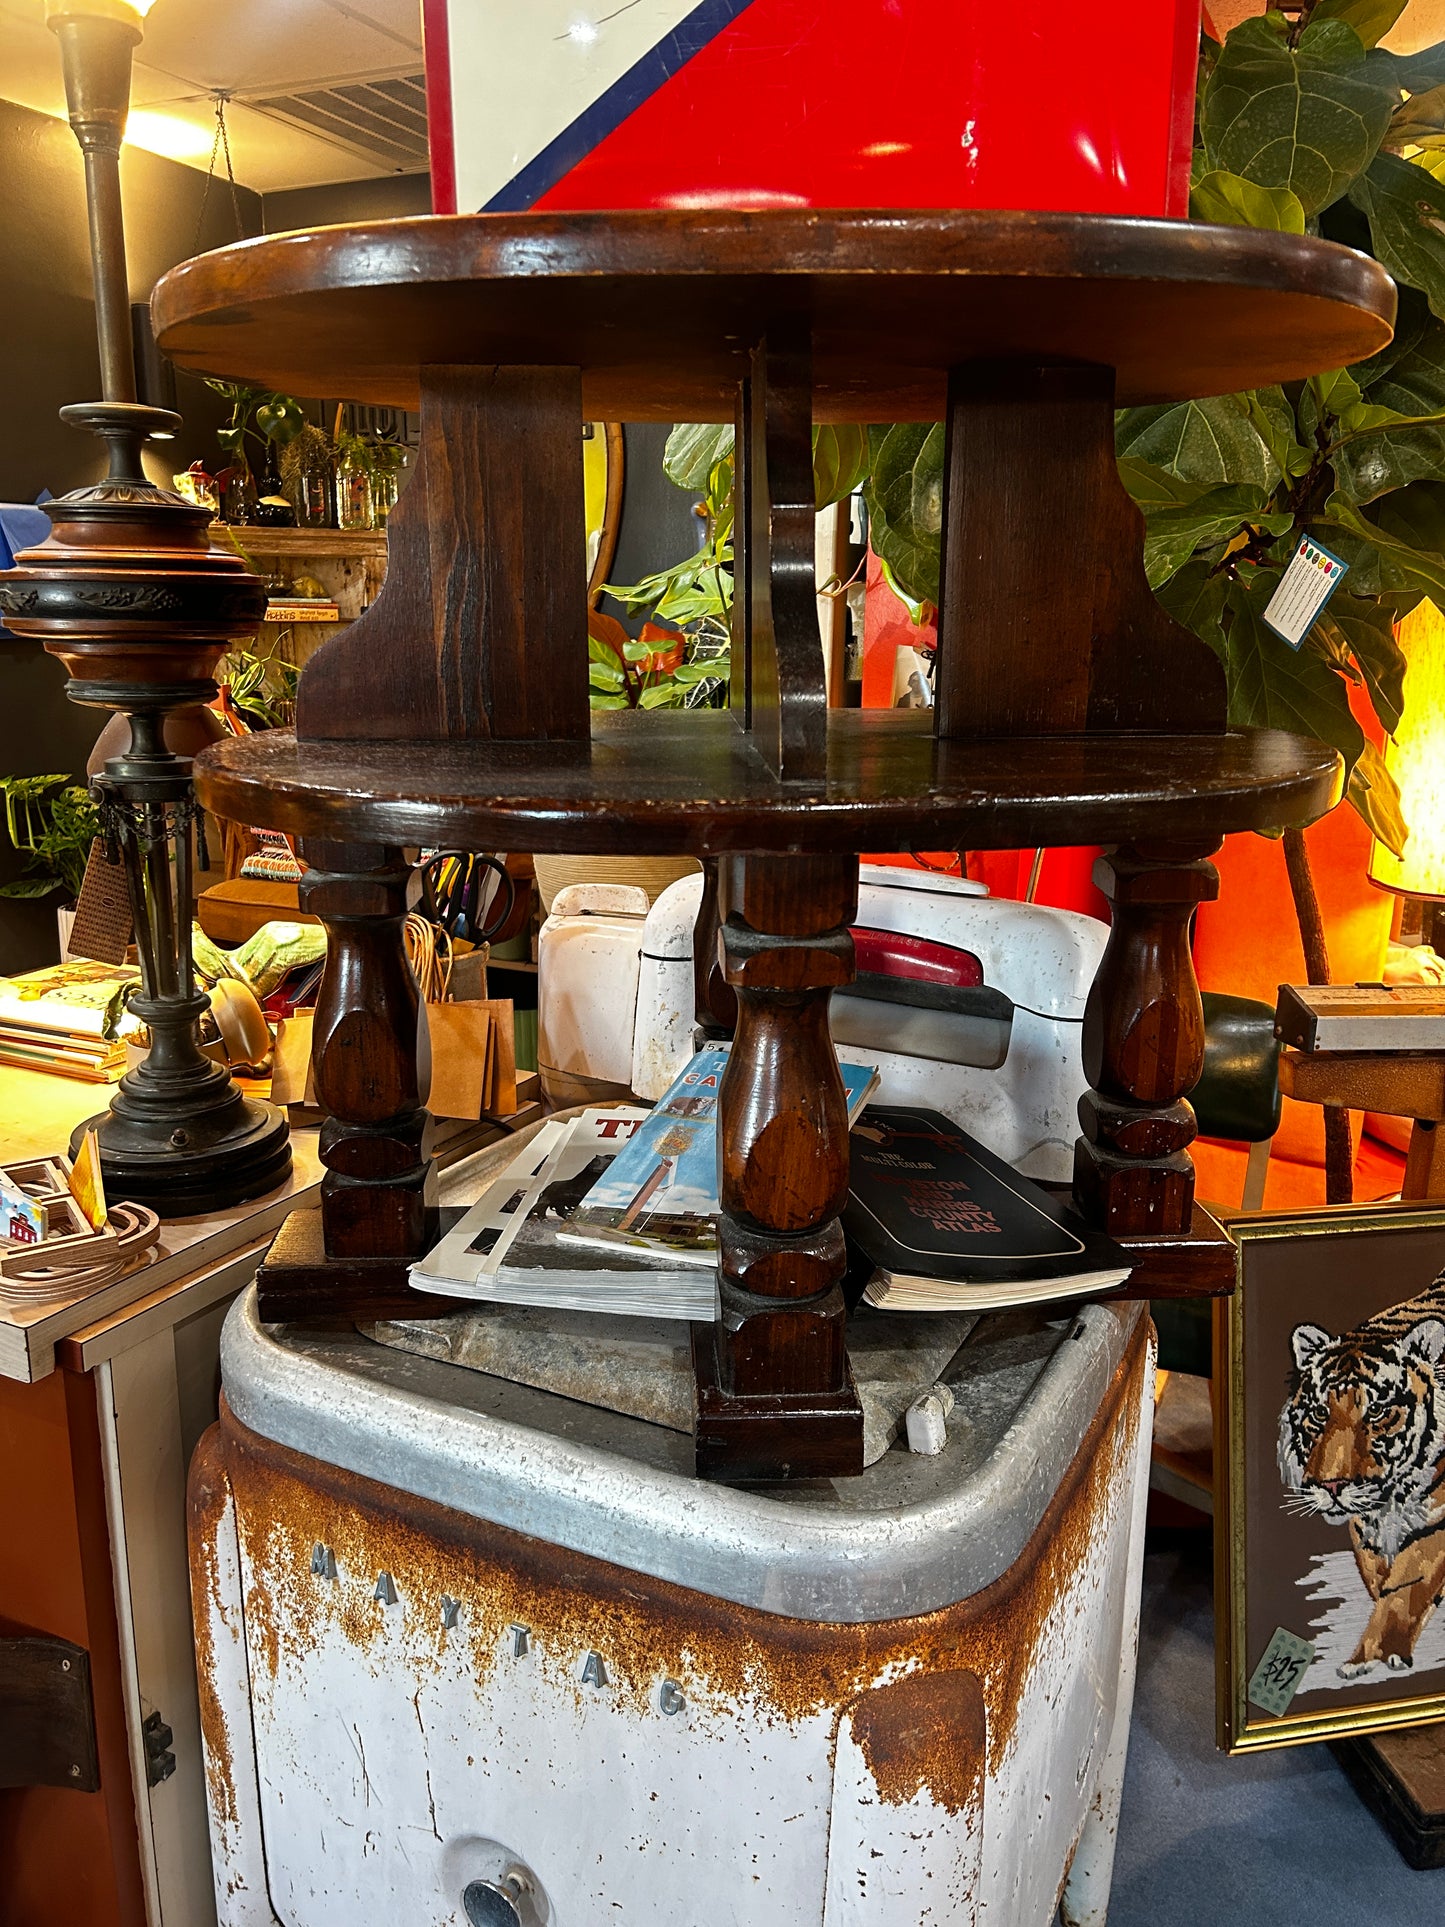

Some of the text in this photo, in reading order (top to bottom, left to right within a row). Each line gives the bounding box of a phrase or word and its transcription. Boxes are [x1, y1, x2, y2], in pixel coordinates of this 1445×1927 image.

[902, 1195, 982, 1211] HARRIS
[909, 1206, 997, 1222] COUNTY
[931, 1219, 1003, 1233] ATLAS
[311, 1541, 685, 1717] MAYTAG
[1263, 1650, 1307, 1691] $25
